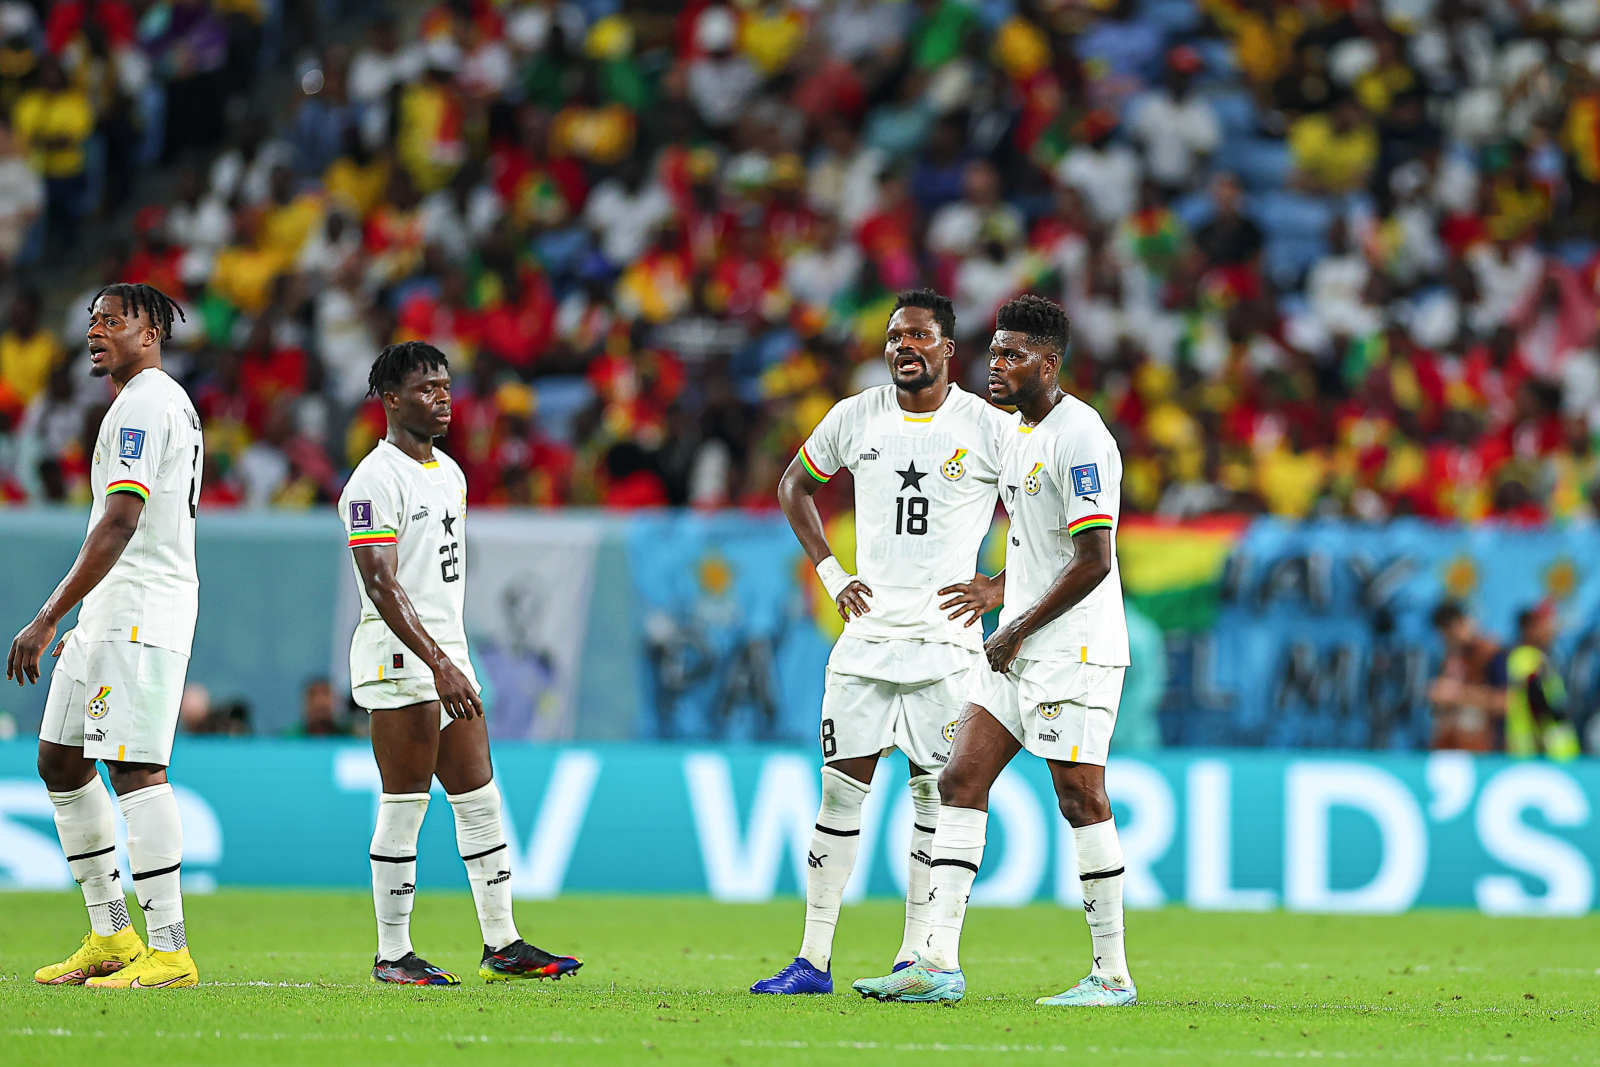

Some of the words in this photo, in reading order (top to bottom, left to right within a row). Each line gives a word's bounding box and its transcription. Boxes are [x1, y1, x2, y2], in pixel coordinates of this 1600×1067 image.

[859, 453, 878, 461] PUMA
[411, 510, 429, 522] PUMA
[895, 496, 929, 535] 18
[1038, 732, 1057, 743] PUMA
[684, 749, 1595, 916] WORLD'S
